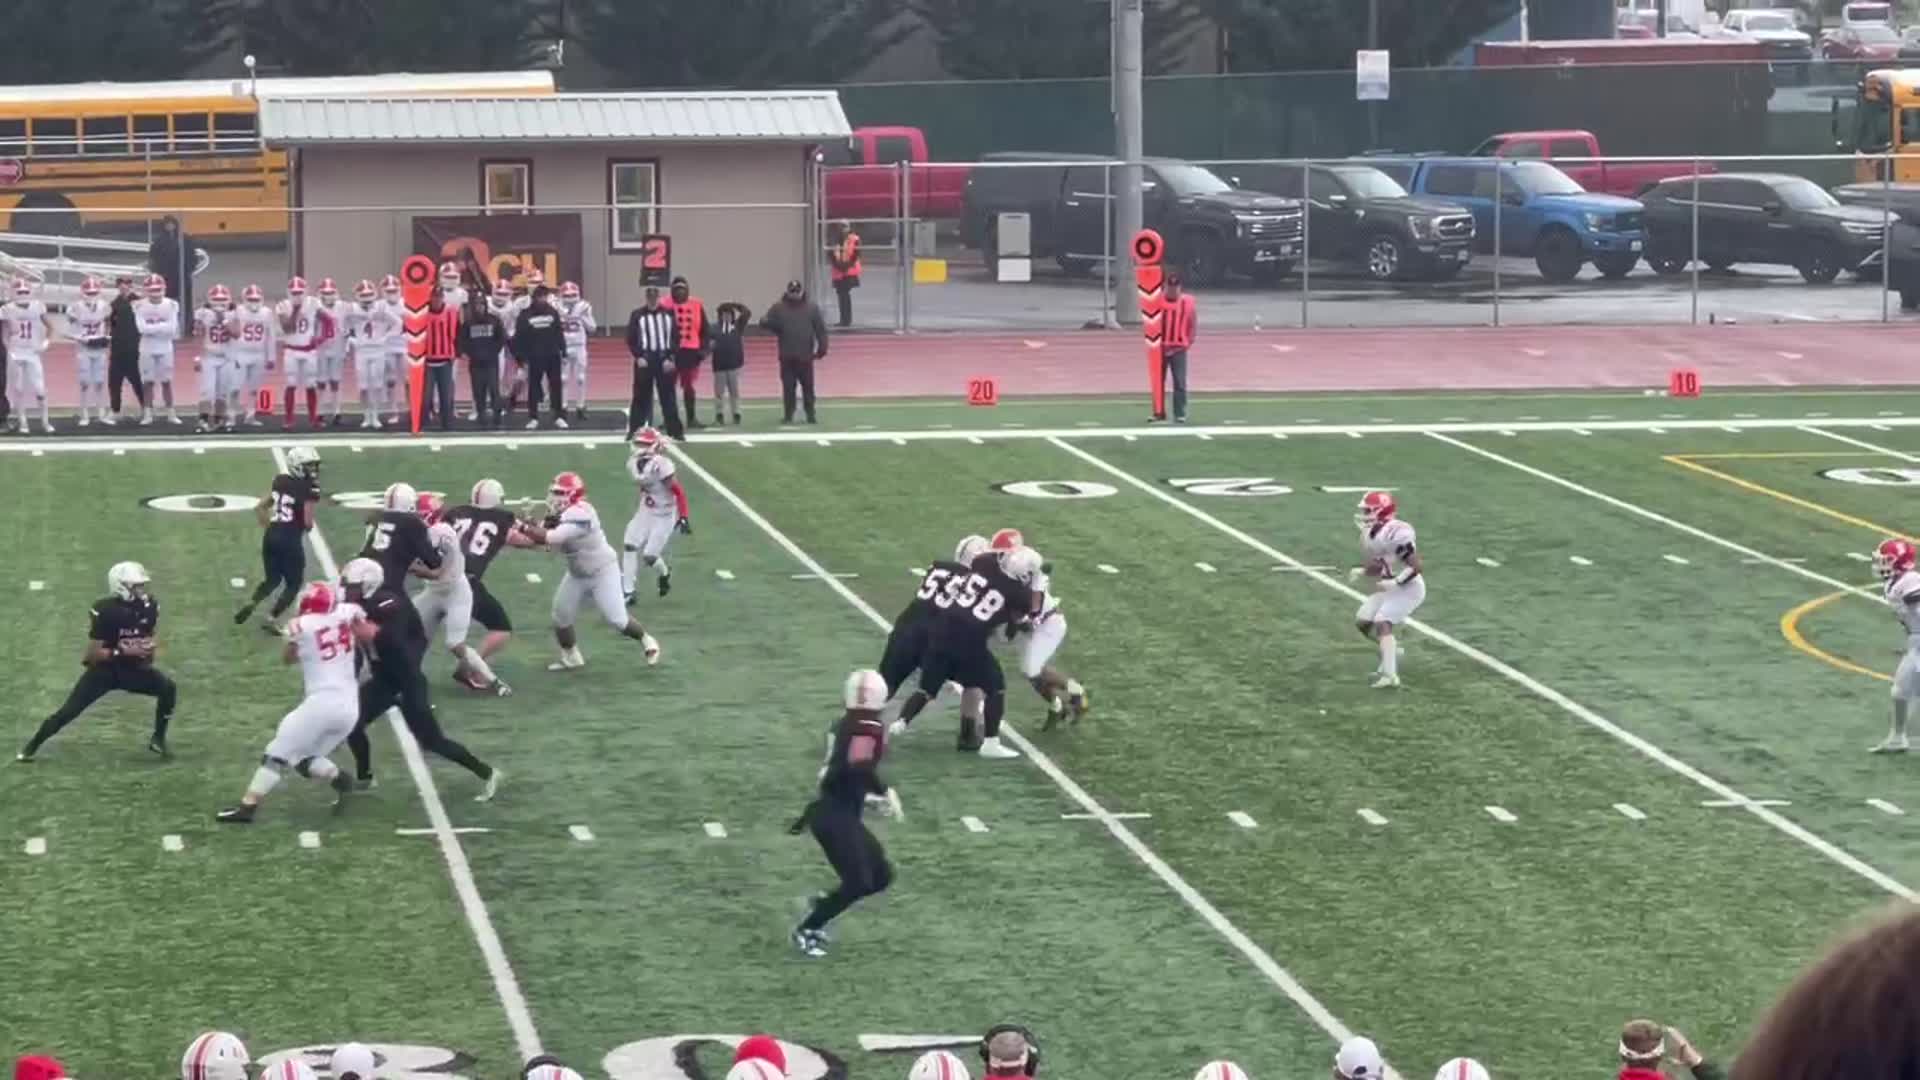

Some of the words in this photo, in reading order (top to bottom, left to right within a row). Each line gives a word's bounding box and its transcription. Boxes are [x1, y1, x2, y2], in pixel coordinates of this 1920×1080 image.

[645, 239, 667, 268] 2
[970, 380, 993, 400] 20
[1676, 372, 1696, 392] 10
[453, 517, 499, 556] 76
[956, 573, 1005, 622] 58
[314, 621, 352, 660] 54
